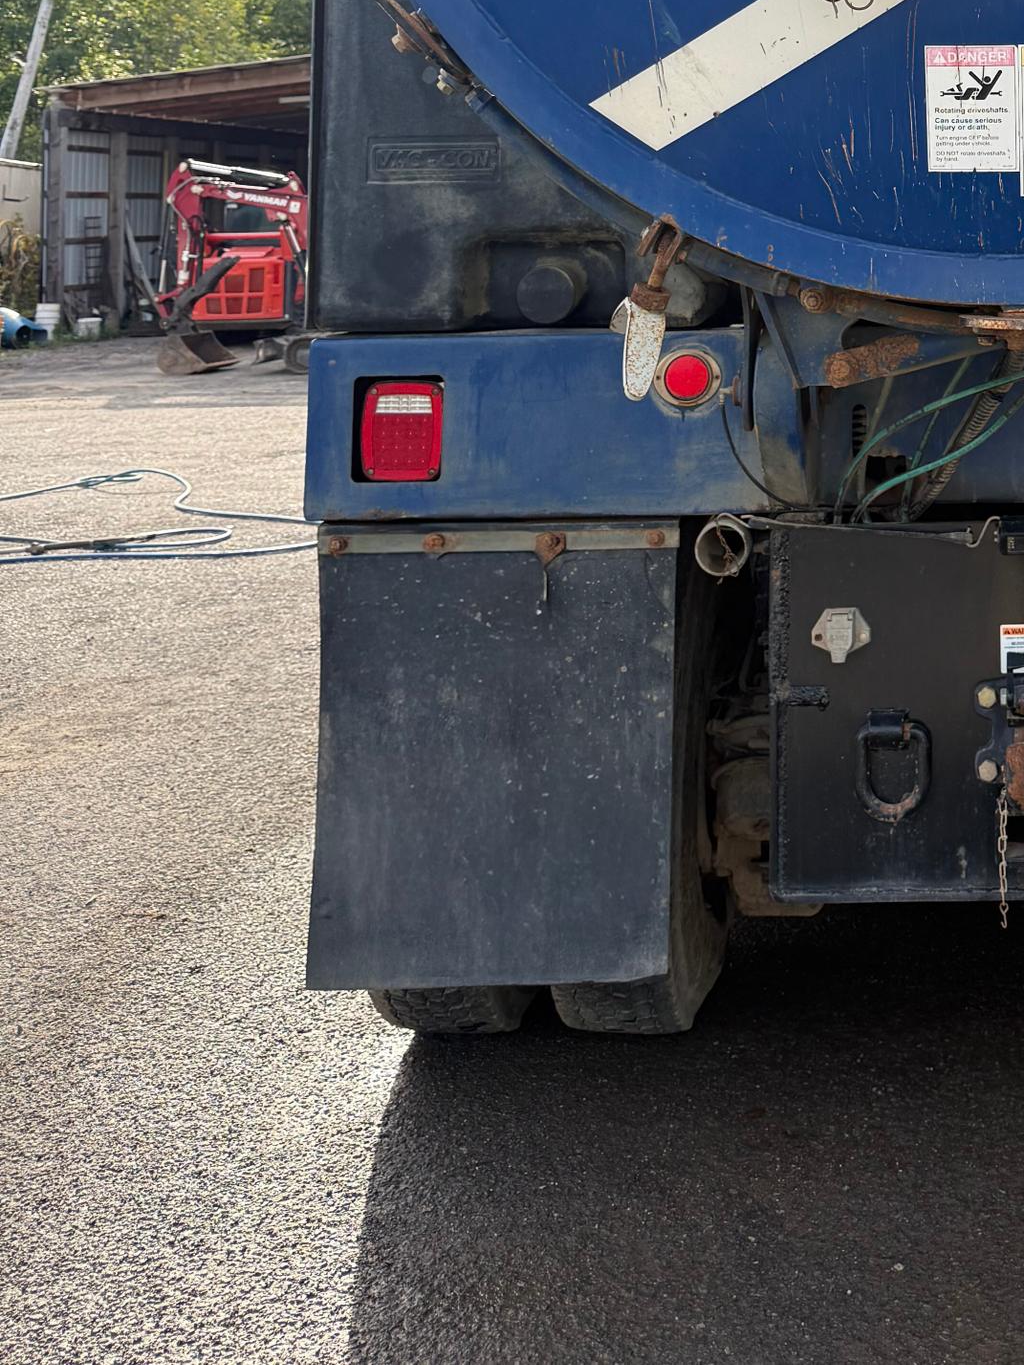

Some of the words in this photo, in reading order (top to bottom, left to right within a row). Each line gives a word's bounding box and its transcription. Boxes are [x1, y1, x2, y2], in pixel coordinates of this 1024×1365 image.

[946, 51, 1007, 63] DANGER
[934, 107, 966, 115] Rotating
[967, 106, 1009, 114] driveshafts
[244, 192, 289, 207] YANMAR
